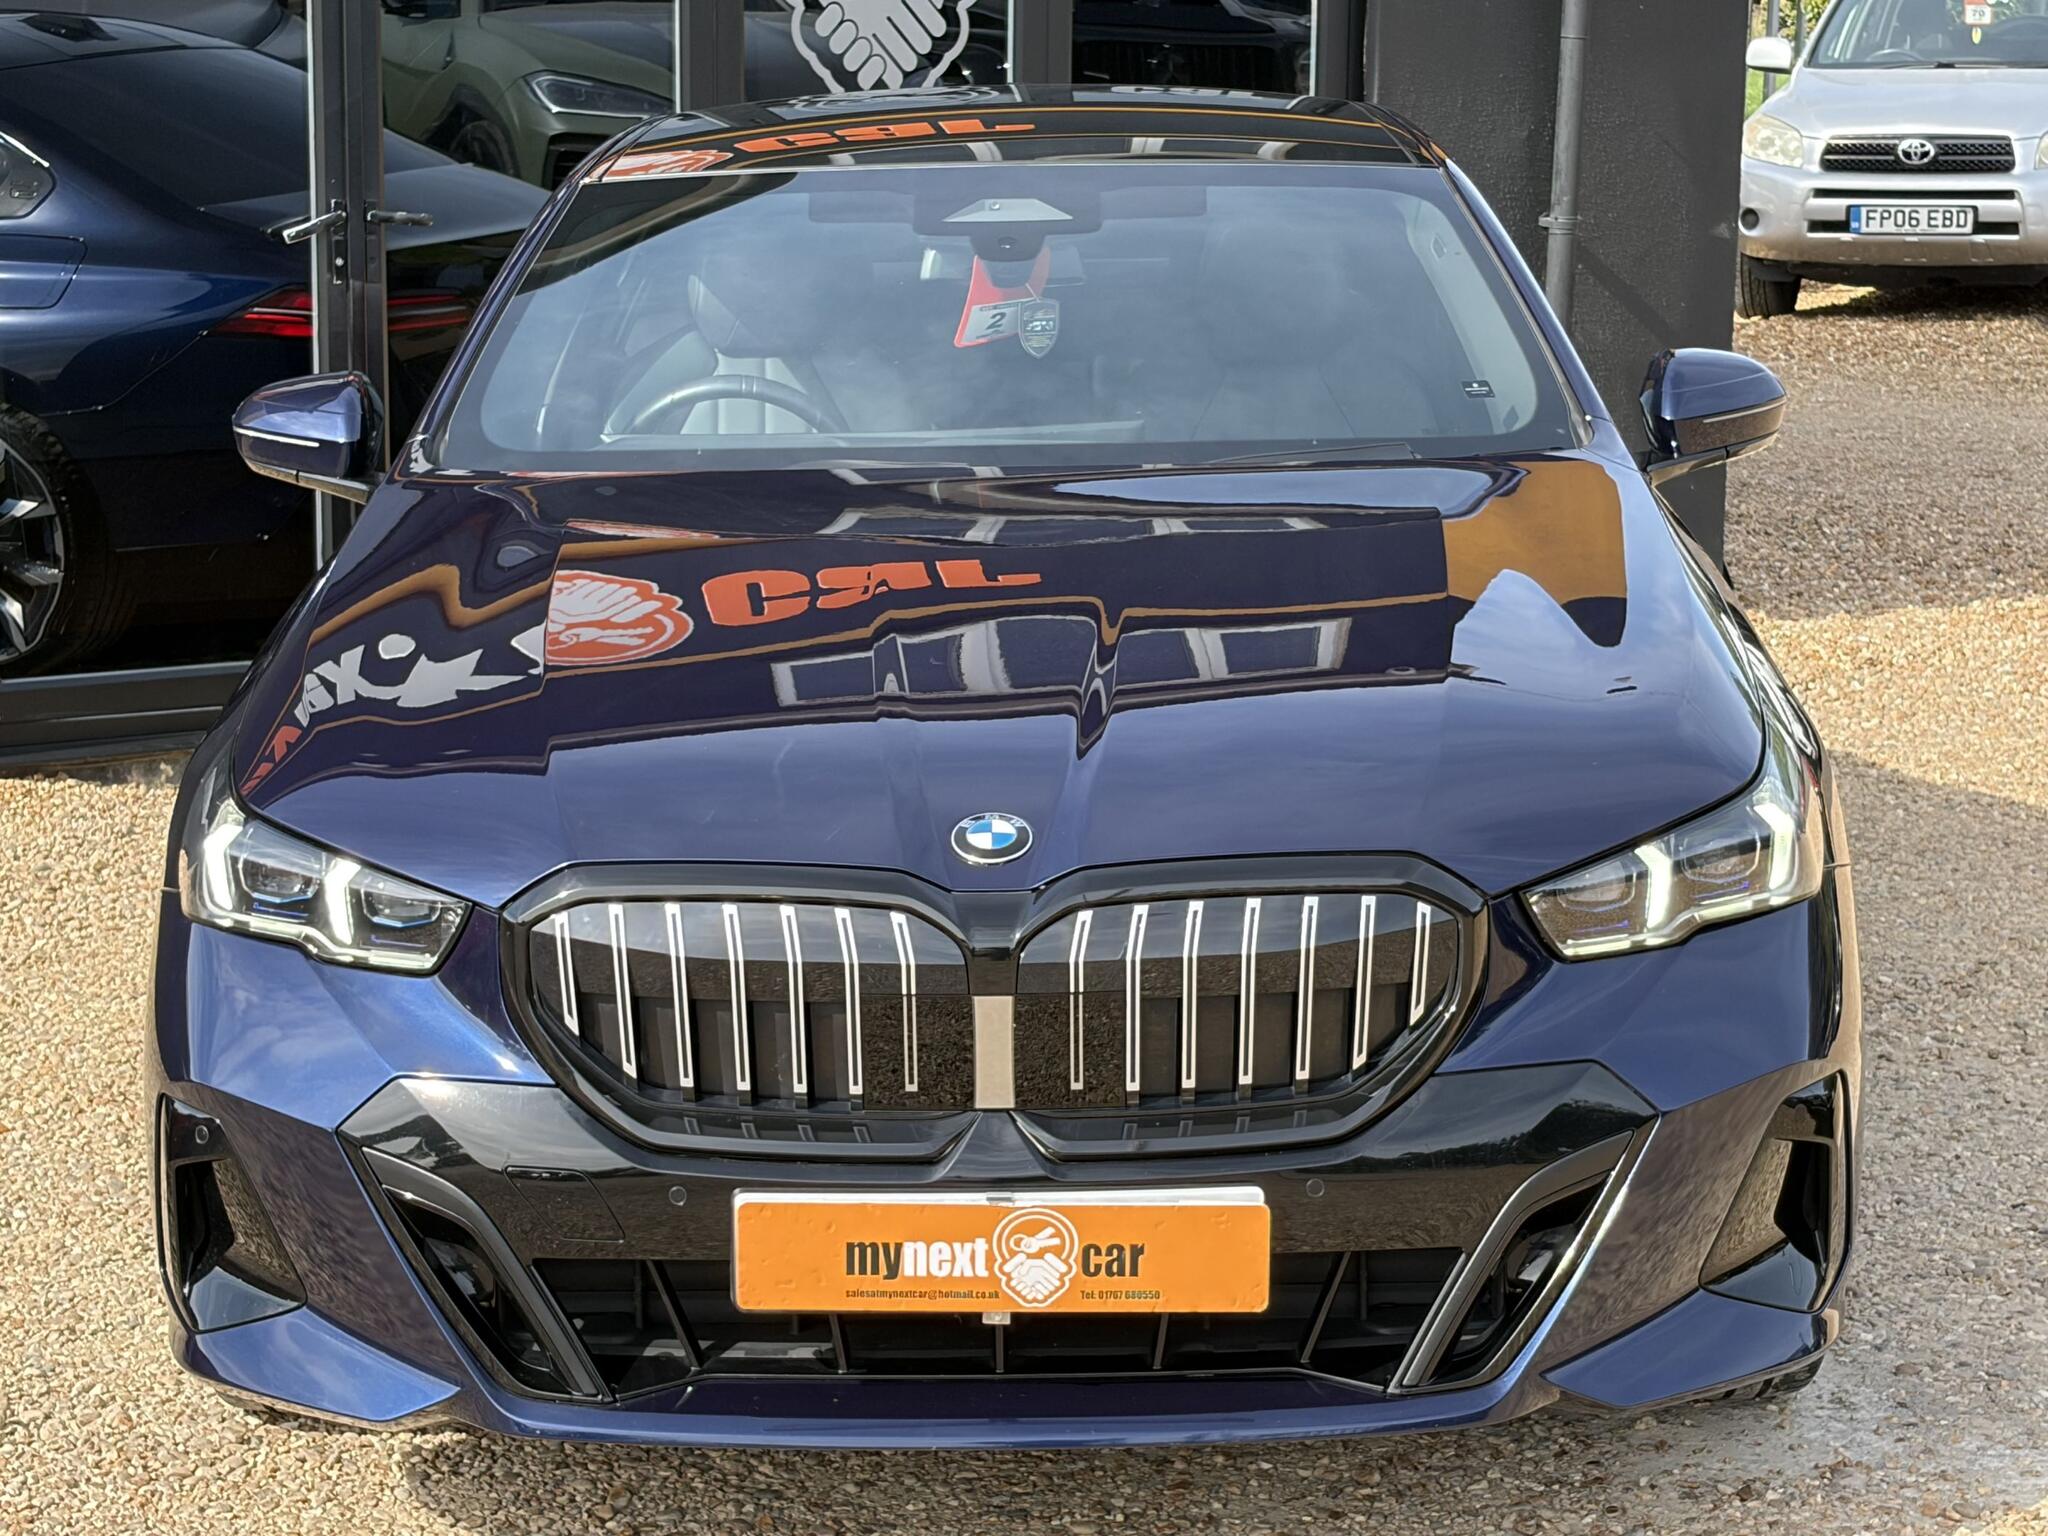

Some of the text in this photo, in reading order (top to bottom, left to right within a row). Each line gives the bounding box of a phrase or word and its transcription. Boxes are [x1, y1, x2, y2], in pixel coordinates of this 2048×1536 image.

[1865, 209, 1968, 229] FP06 EBD
[986, 311, 1007, 330] 2
[1081, 1243, 1145, 1278] car
